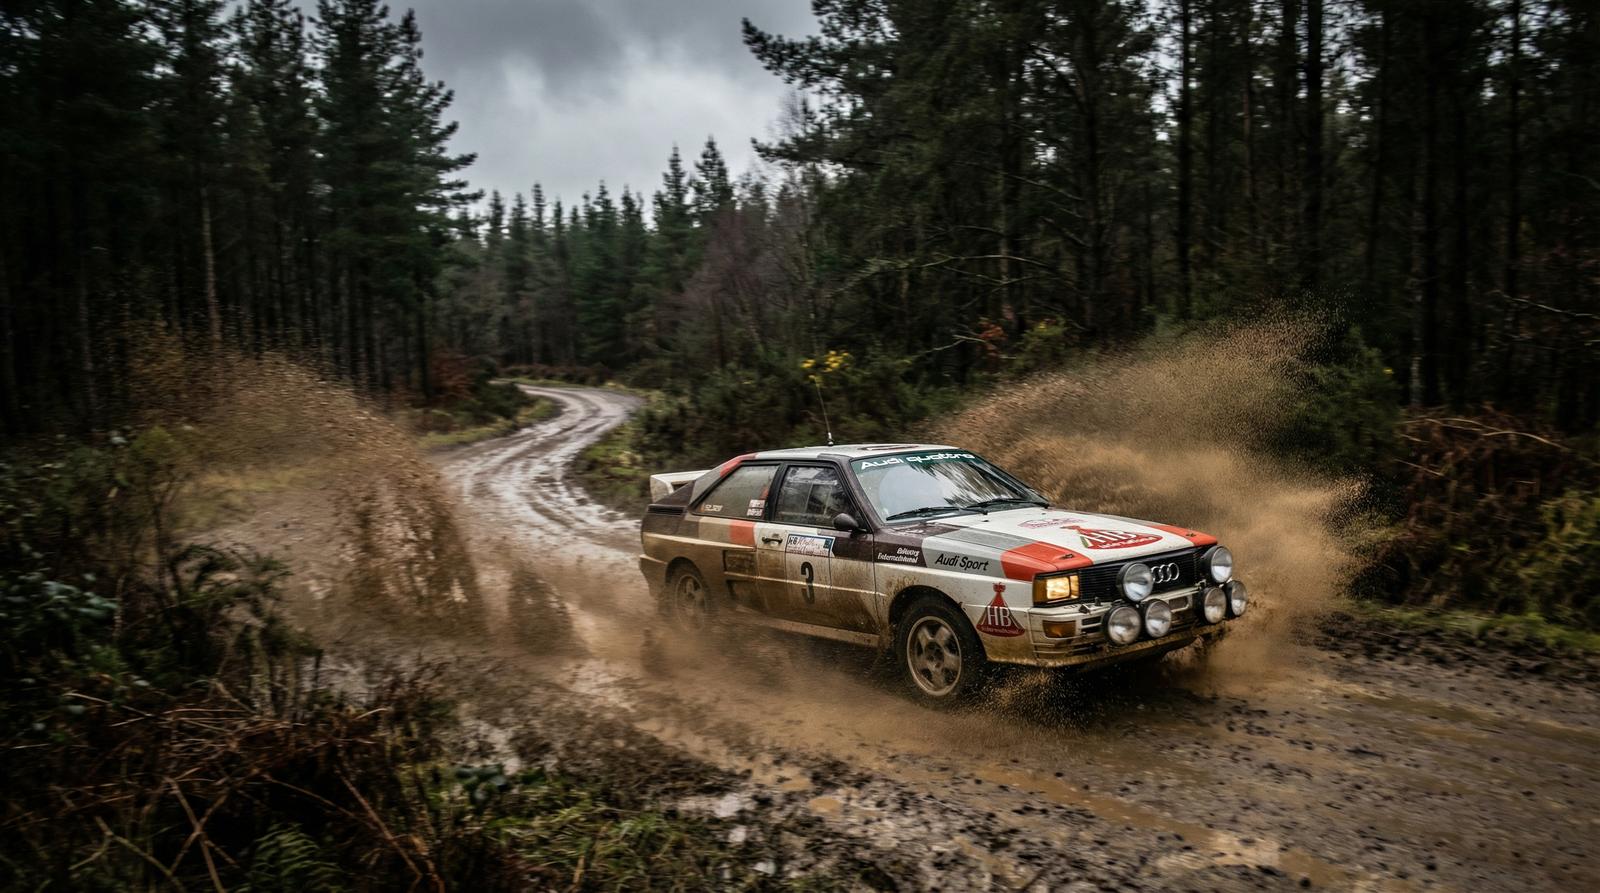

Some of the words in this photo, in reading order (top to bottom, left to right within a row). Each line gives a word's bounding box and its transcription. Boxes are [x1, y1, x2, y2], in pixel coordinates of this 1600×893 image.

[861, 458, 904, 470] Audi
[935, 553, 960, 565] Audi
[960, 556, 989, 571] Sport
[801, 561, 815, 605] 3
[987, 605, 1012, 627] HB
